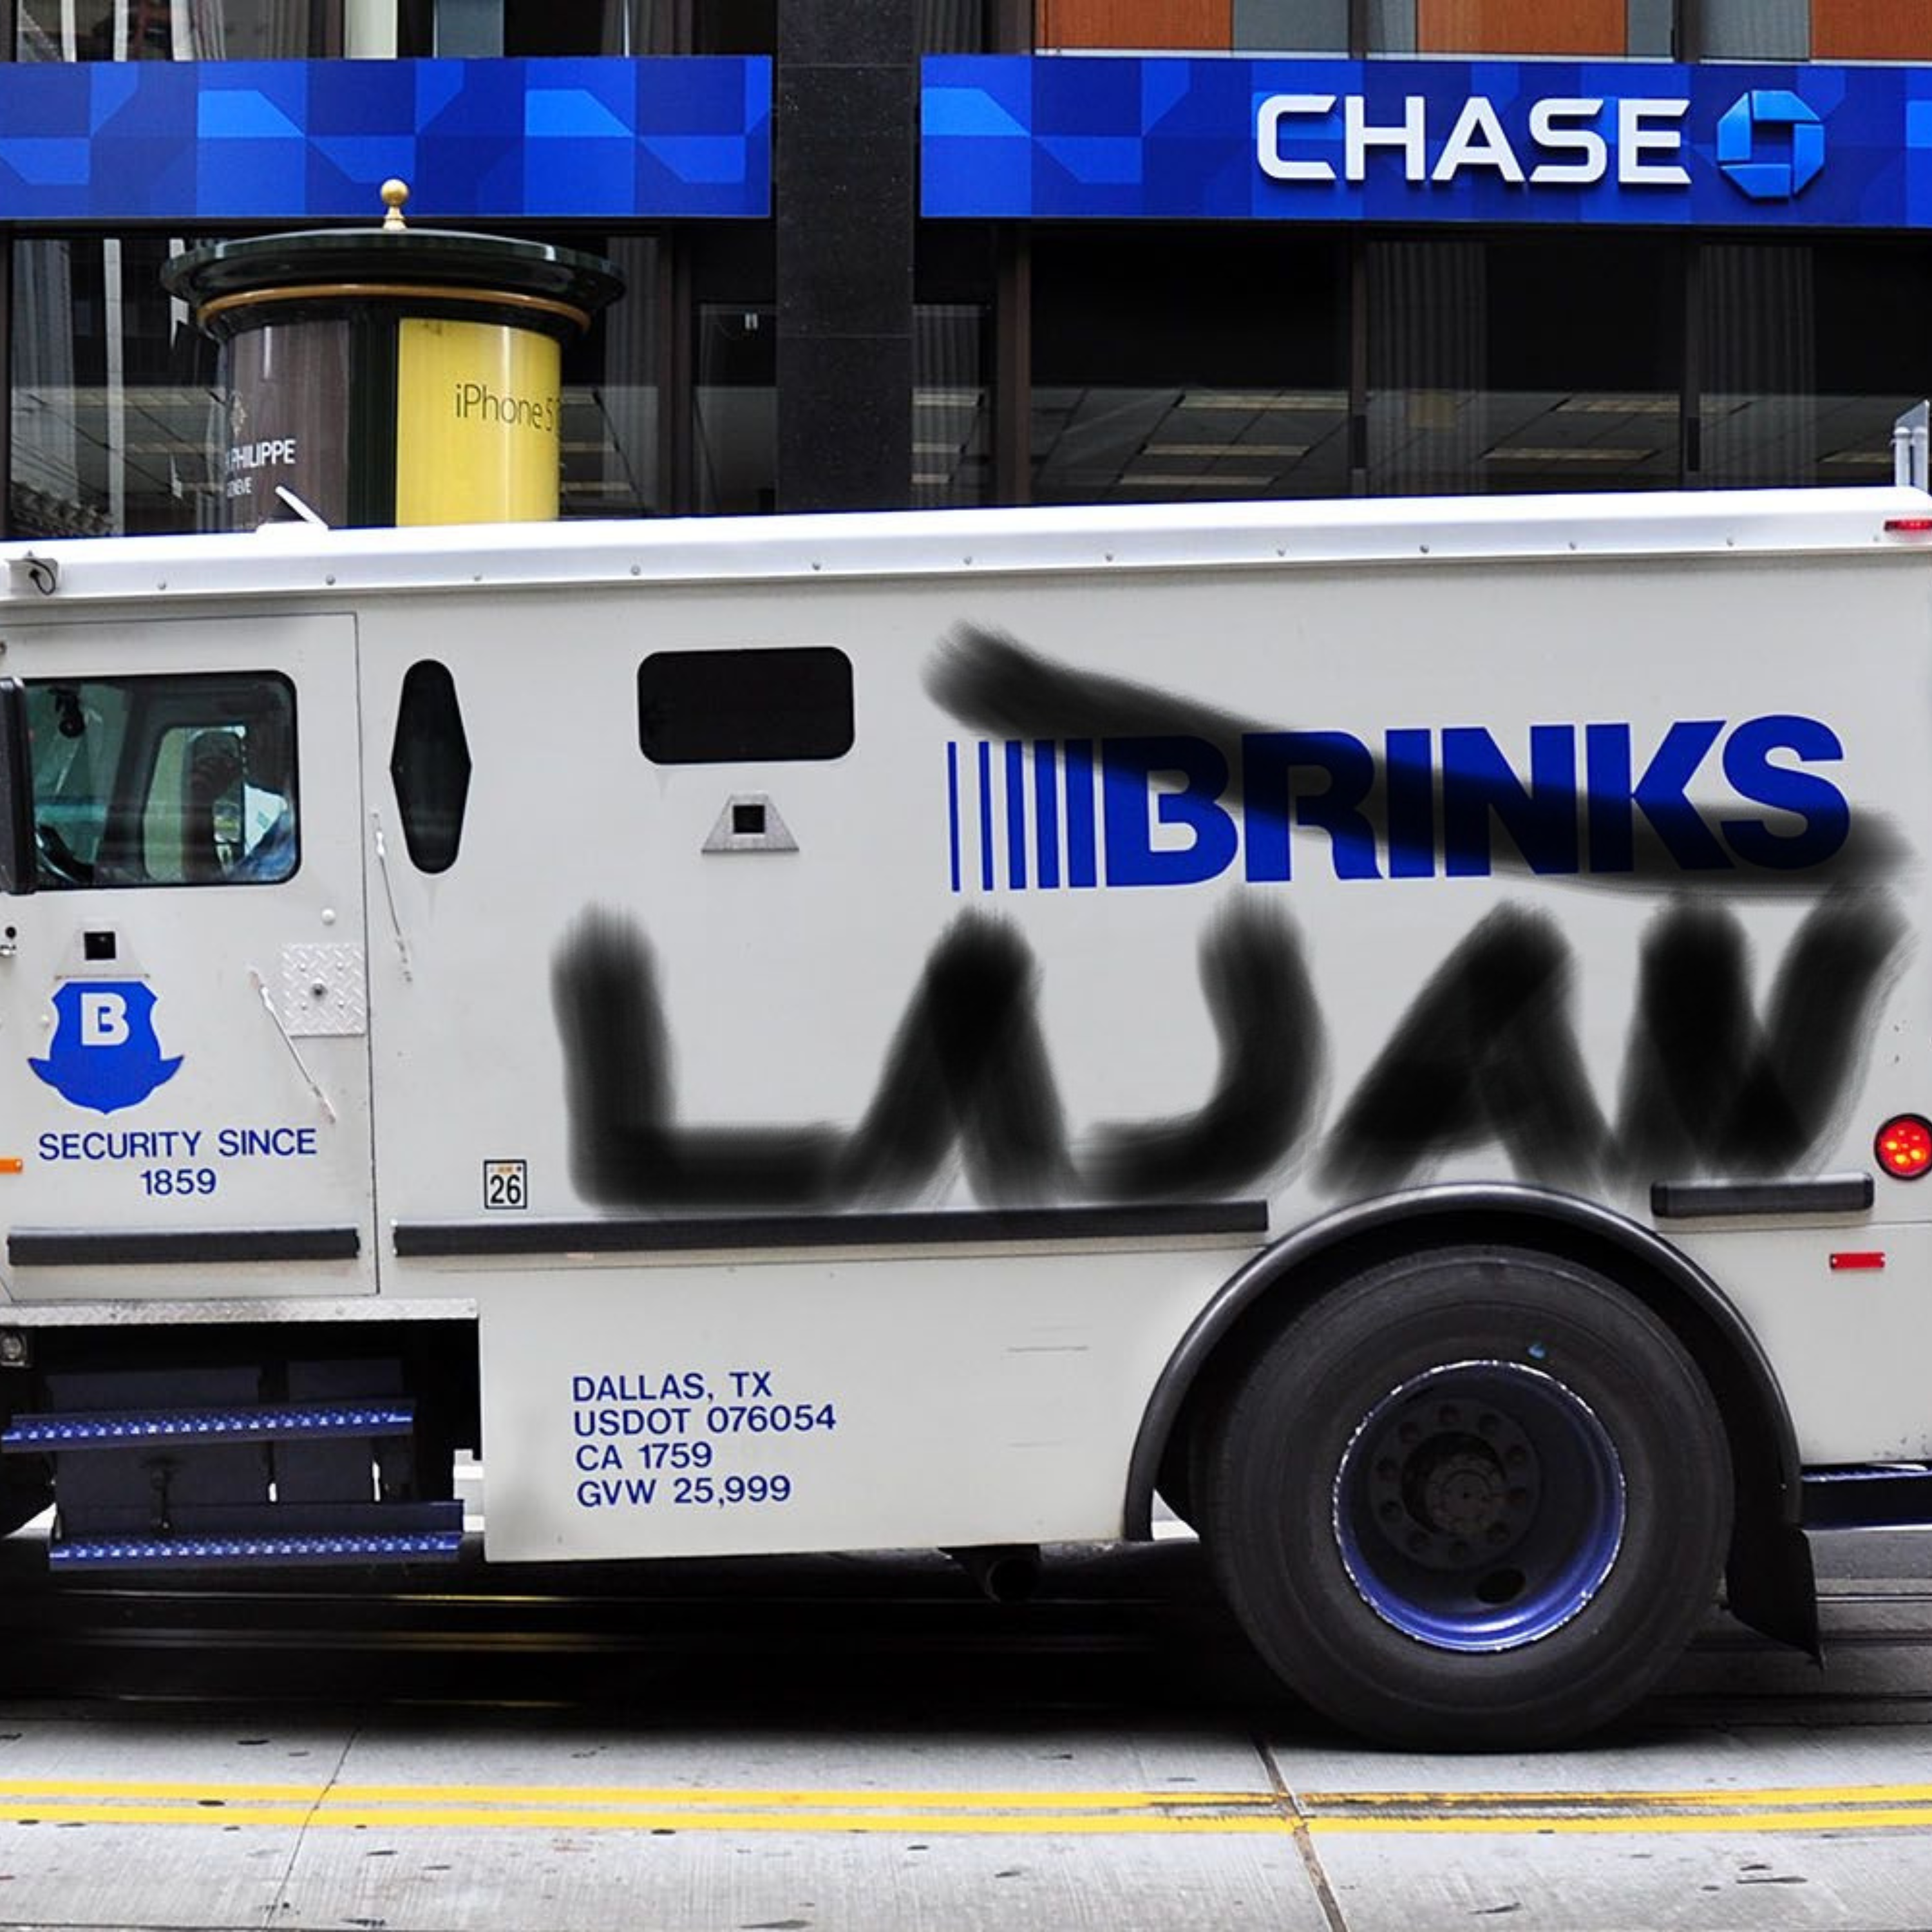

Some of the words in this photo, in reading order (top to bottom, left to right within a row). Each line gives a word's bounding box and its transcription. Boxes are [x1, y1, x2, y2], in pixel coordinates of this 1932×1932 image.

[1258, 95, 1690, 183] CHASE
[455, 383, 543, 430] iPhone
[1101, 714, 1851, 887] BRINKS
[80, 992, 129, 1046] B
[39, 1131, 201, 1160] SECURITY
[219, 1128, 317, 1157] SINCE
[141, 1168, 216, 1195] 1859
[490, 1174, 522, 1204] 26
[573, 1373, 713, 1401] DALLAS,
[729, 1372, 772, 1397] TX
[574, 1408, 691, 1436] USDOT
[708, 1404, 836, 1433] 076054
[576, 1444, 622, 1471] CA
[639, 1441, 712, 1468] 1759
[578, 1479, 656, 1507] GVW
[674, 1475, 790, 1506] 25,999
